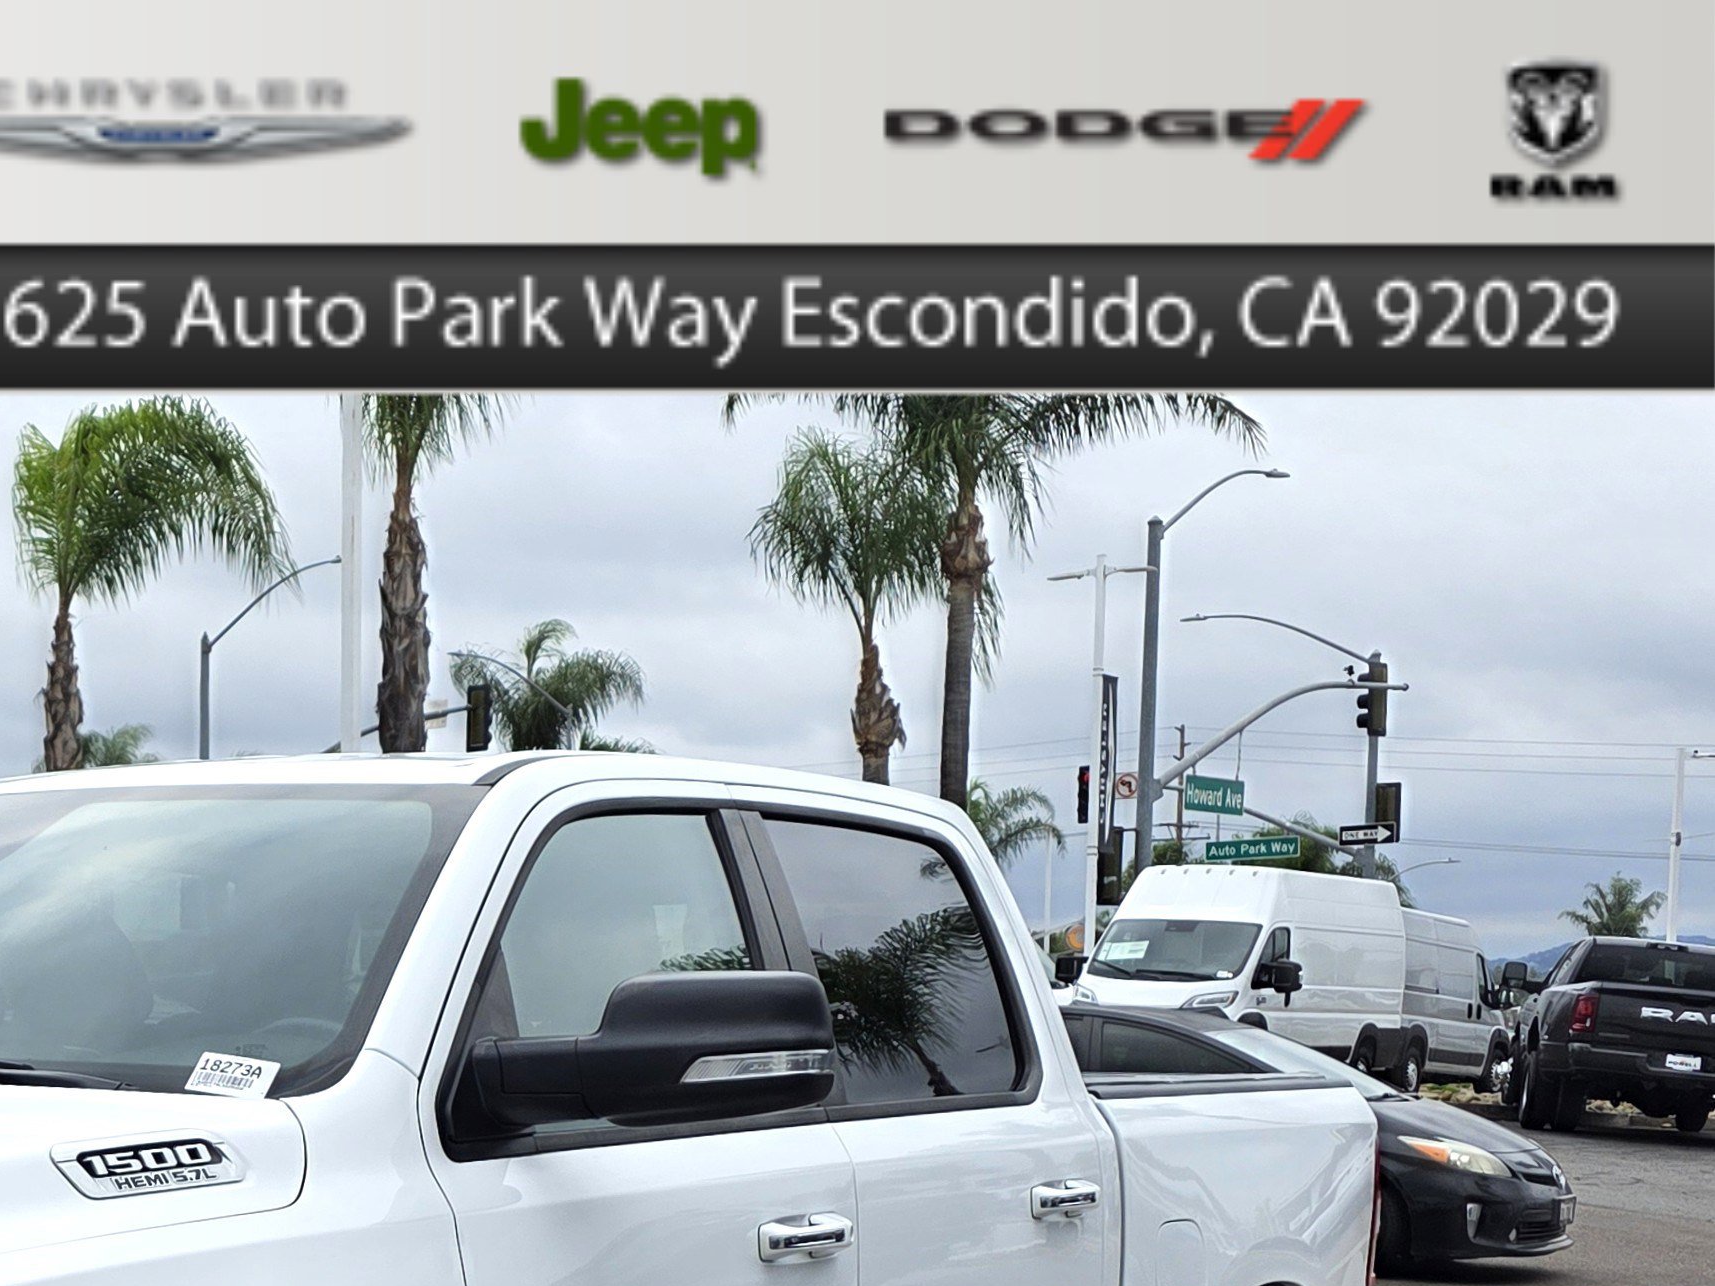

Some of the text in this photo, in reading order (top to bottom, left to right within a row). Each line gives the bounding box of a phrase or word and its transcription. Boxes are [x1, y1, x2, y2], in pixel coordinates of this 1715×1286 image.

[1187, 783, 1243, 809] Howard Ave
[1208, 840, 1296, 857] Auto Park Way
[1640, 1006, 1715, 1026] RA
[200, 1058, 262, 1079] 18273A
[85, 1142, 213, 1176] 1500
[114, 1167, 217, 1191] HEMI 5.7L
